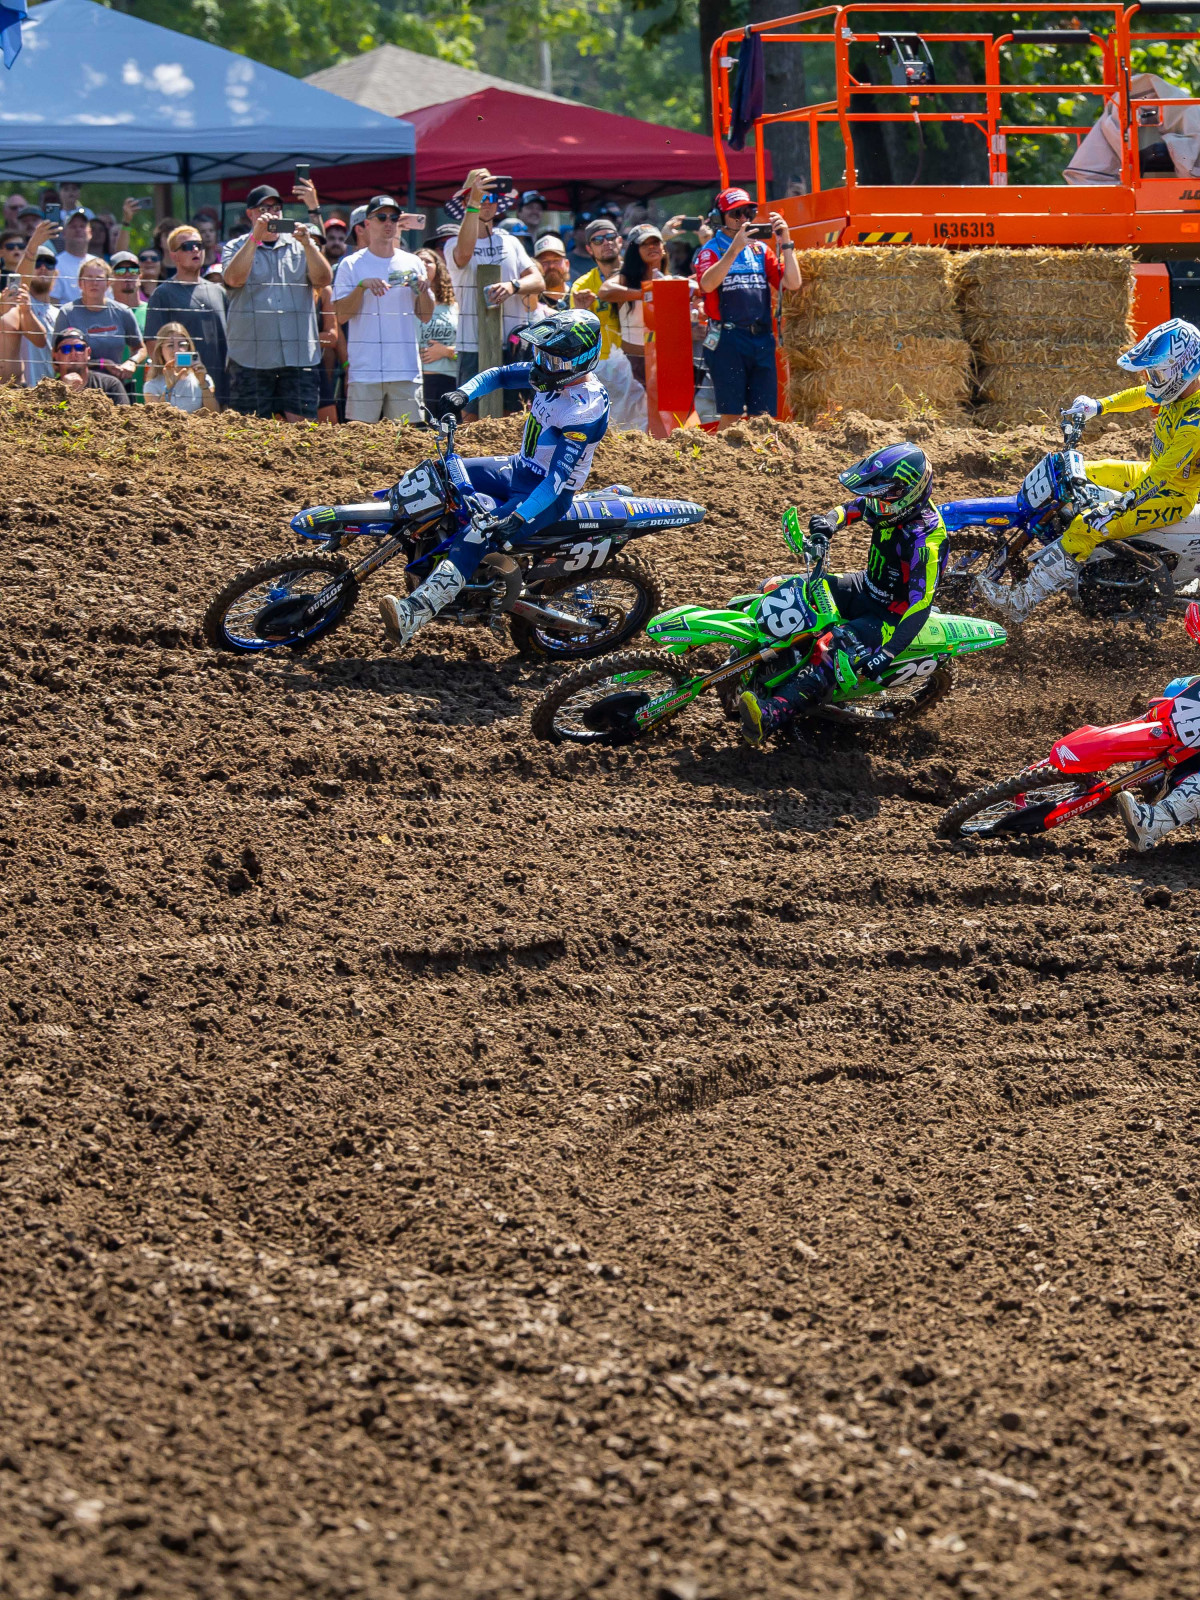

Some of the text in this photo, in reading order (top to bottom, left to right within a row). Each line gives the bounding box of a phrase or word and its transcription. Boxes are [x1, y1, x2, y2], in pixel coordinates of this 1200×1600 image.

[933, 222, 995, 238] 1636313
[723, 274, 766, 286] GASGA
[398, 468, 442, 516] 31
[1025, 458, 1053, 509] 69
[649, 517, 691, 526] DUNLOP
[1135, 505, 1183, 526] FXR
[563, 538, 612, 572] 31
[307, 583, 344, 614] DUNLOP
[762, 587, 806, 638] 29
[867, 653, 887, 671] FOX
[888, 659, 938, 688] 29
[1055, 797, 1101, 823] DUNLOP
